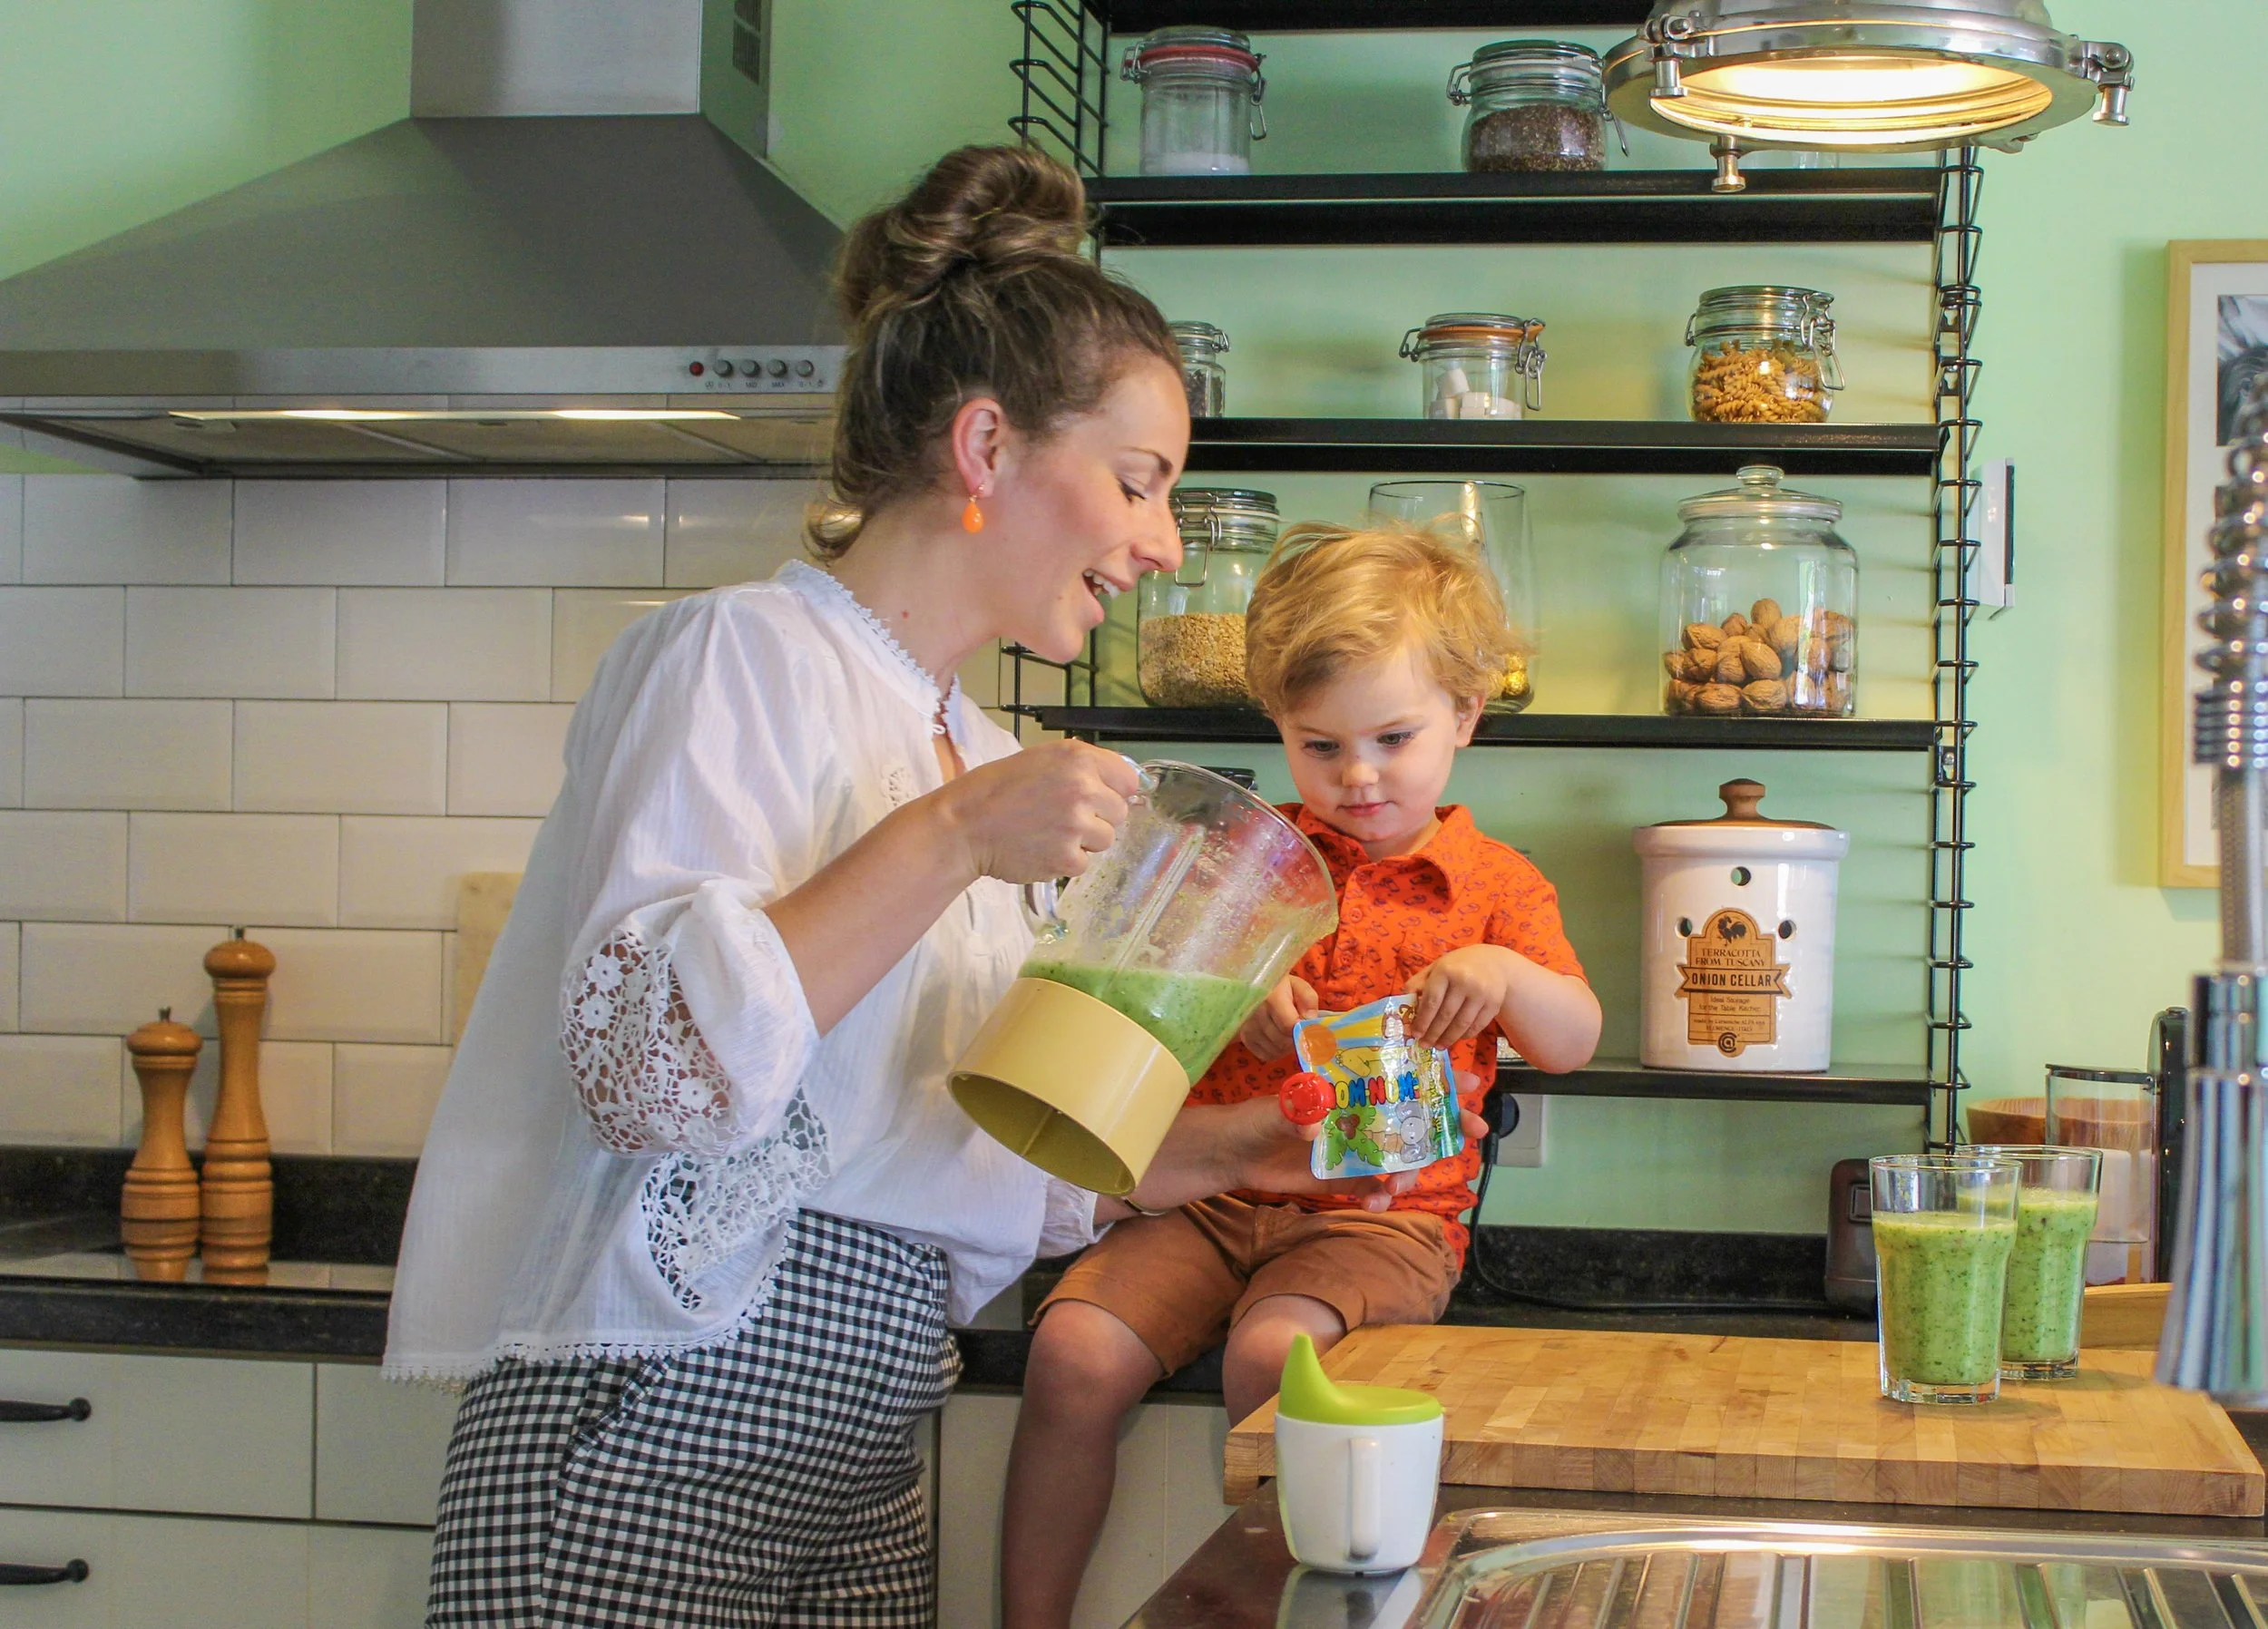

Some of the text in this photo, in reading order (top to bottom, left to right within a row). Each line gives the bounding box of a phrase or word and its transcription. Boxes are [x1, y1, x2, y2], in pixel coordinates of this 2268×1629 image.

[1701, 948, 1761, 958] TERRACOTTA
[1696, 957, 1765, 967] FROM TUSCANY
[1692, 973, 1772, 987] ONION CELLAR
[1329, 1071, 1414, 1110] OM-NOM
